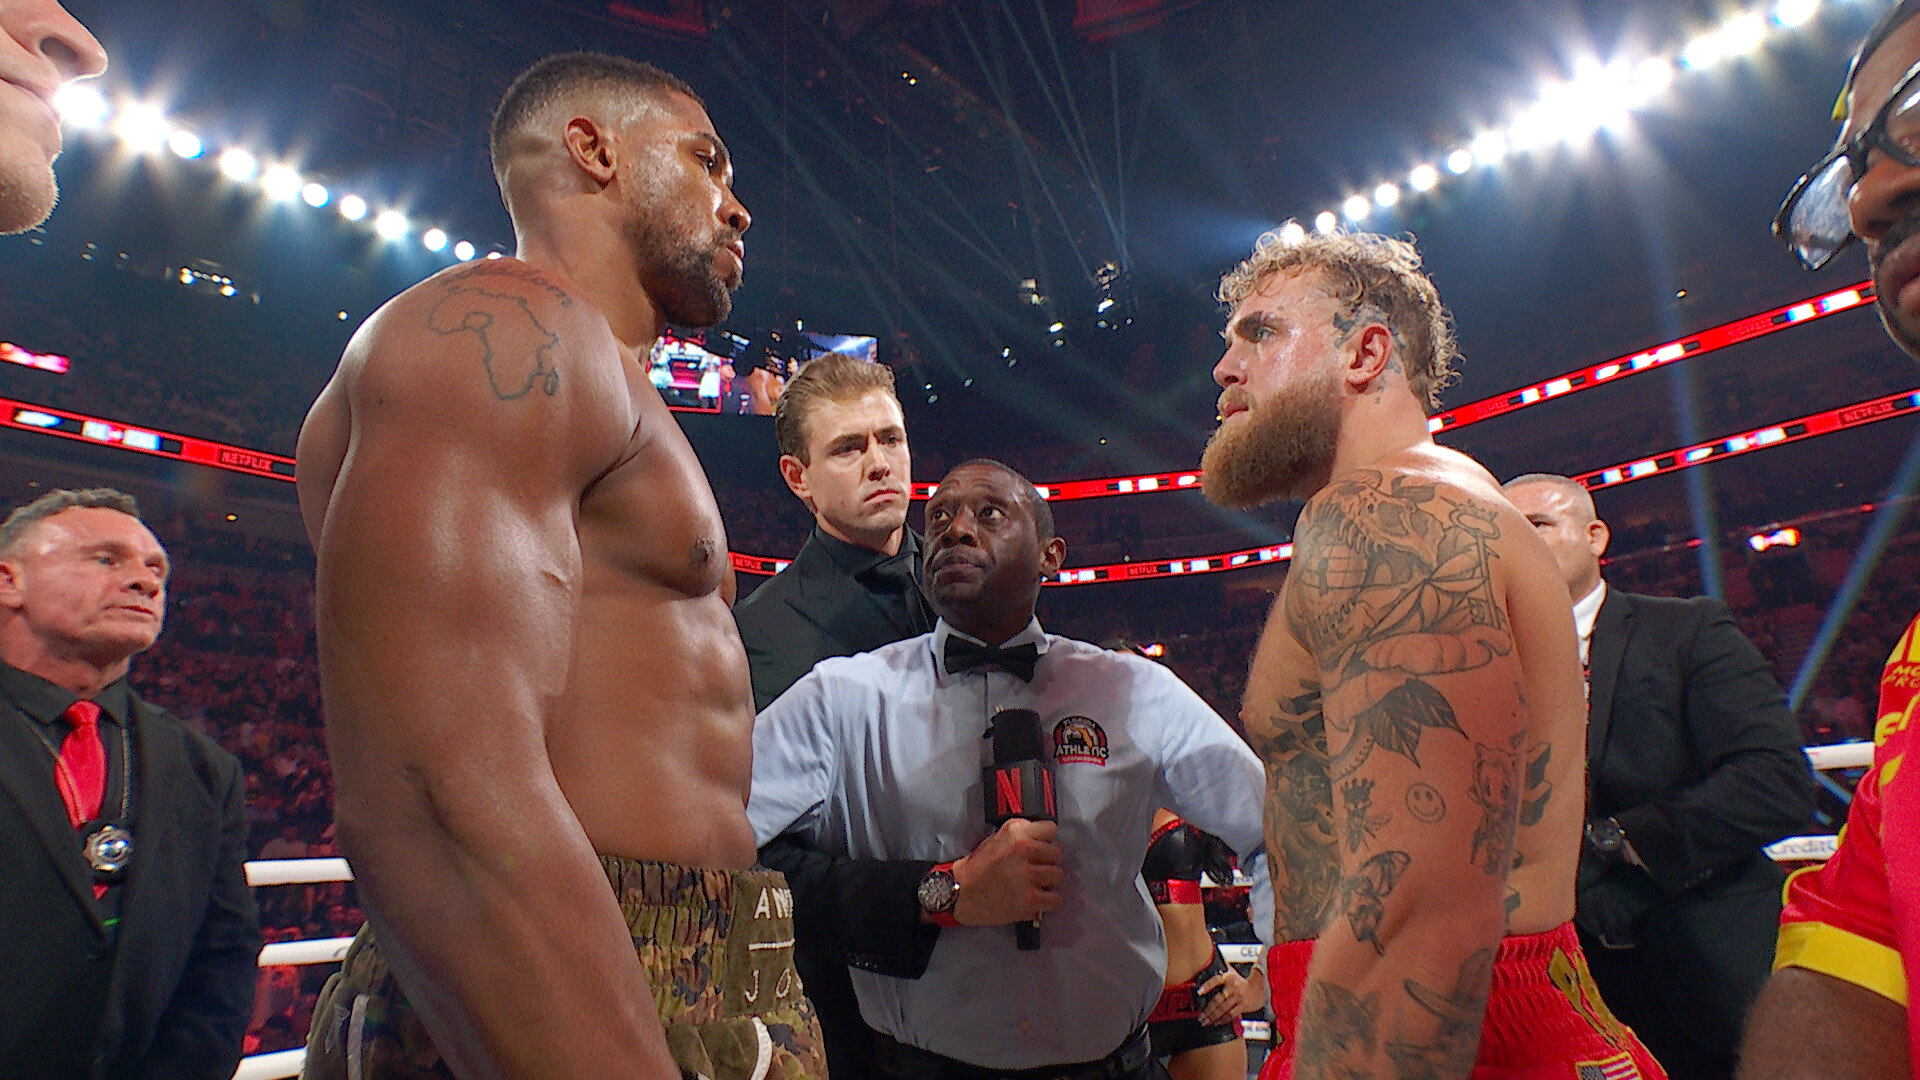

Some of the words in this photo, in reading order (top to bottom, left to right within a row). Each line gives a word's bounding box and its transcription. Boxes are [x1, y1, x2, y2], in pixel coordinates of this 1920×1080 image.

[1843, 401, 1894, 421] NETFLIX
[221, 450, 272, 471] NETFLIX
[1056, 744, 1107, 758] ATHLETIC
[996, 767, 1022, 816] N
[745, 969, 803, 1002] JO
